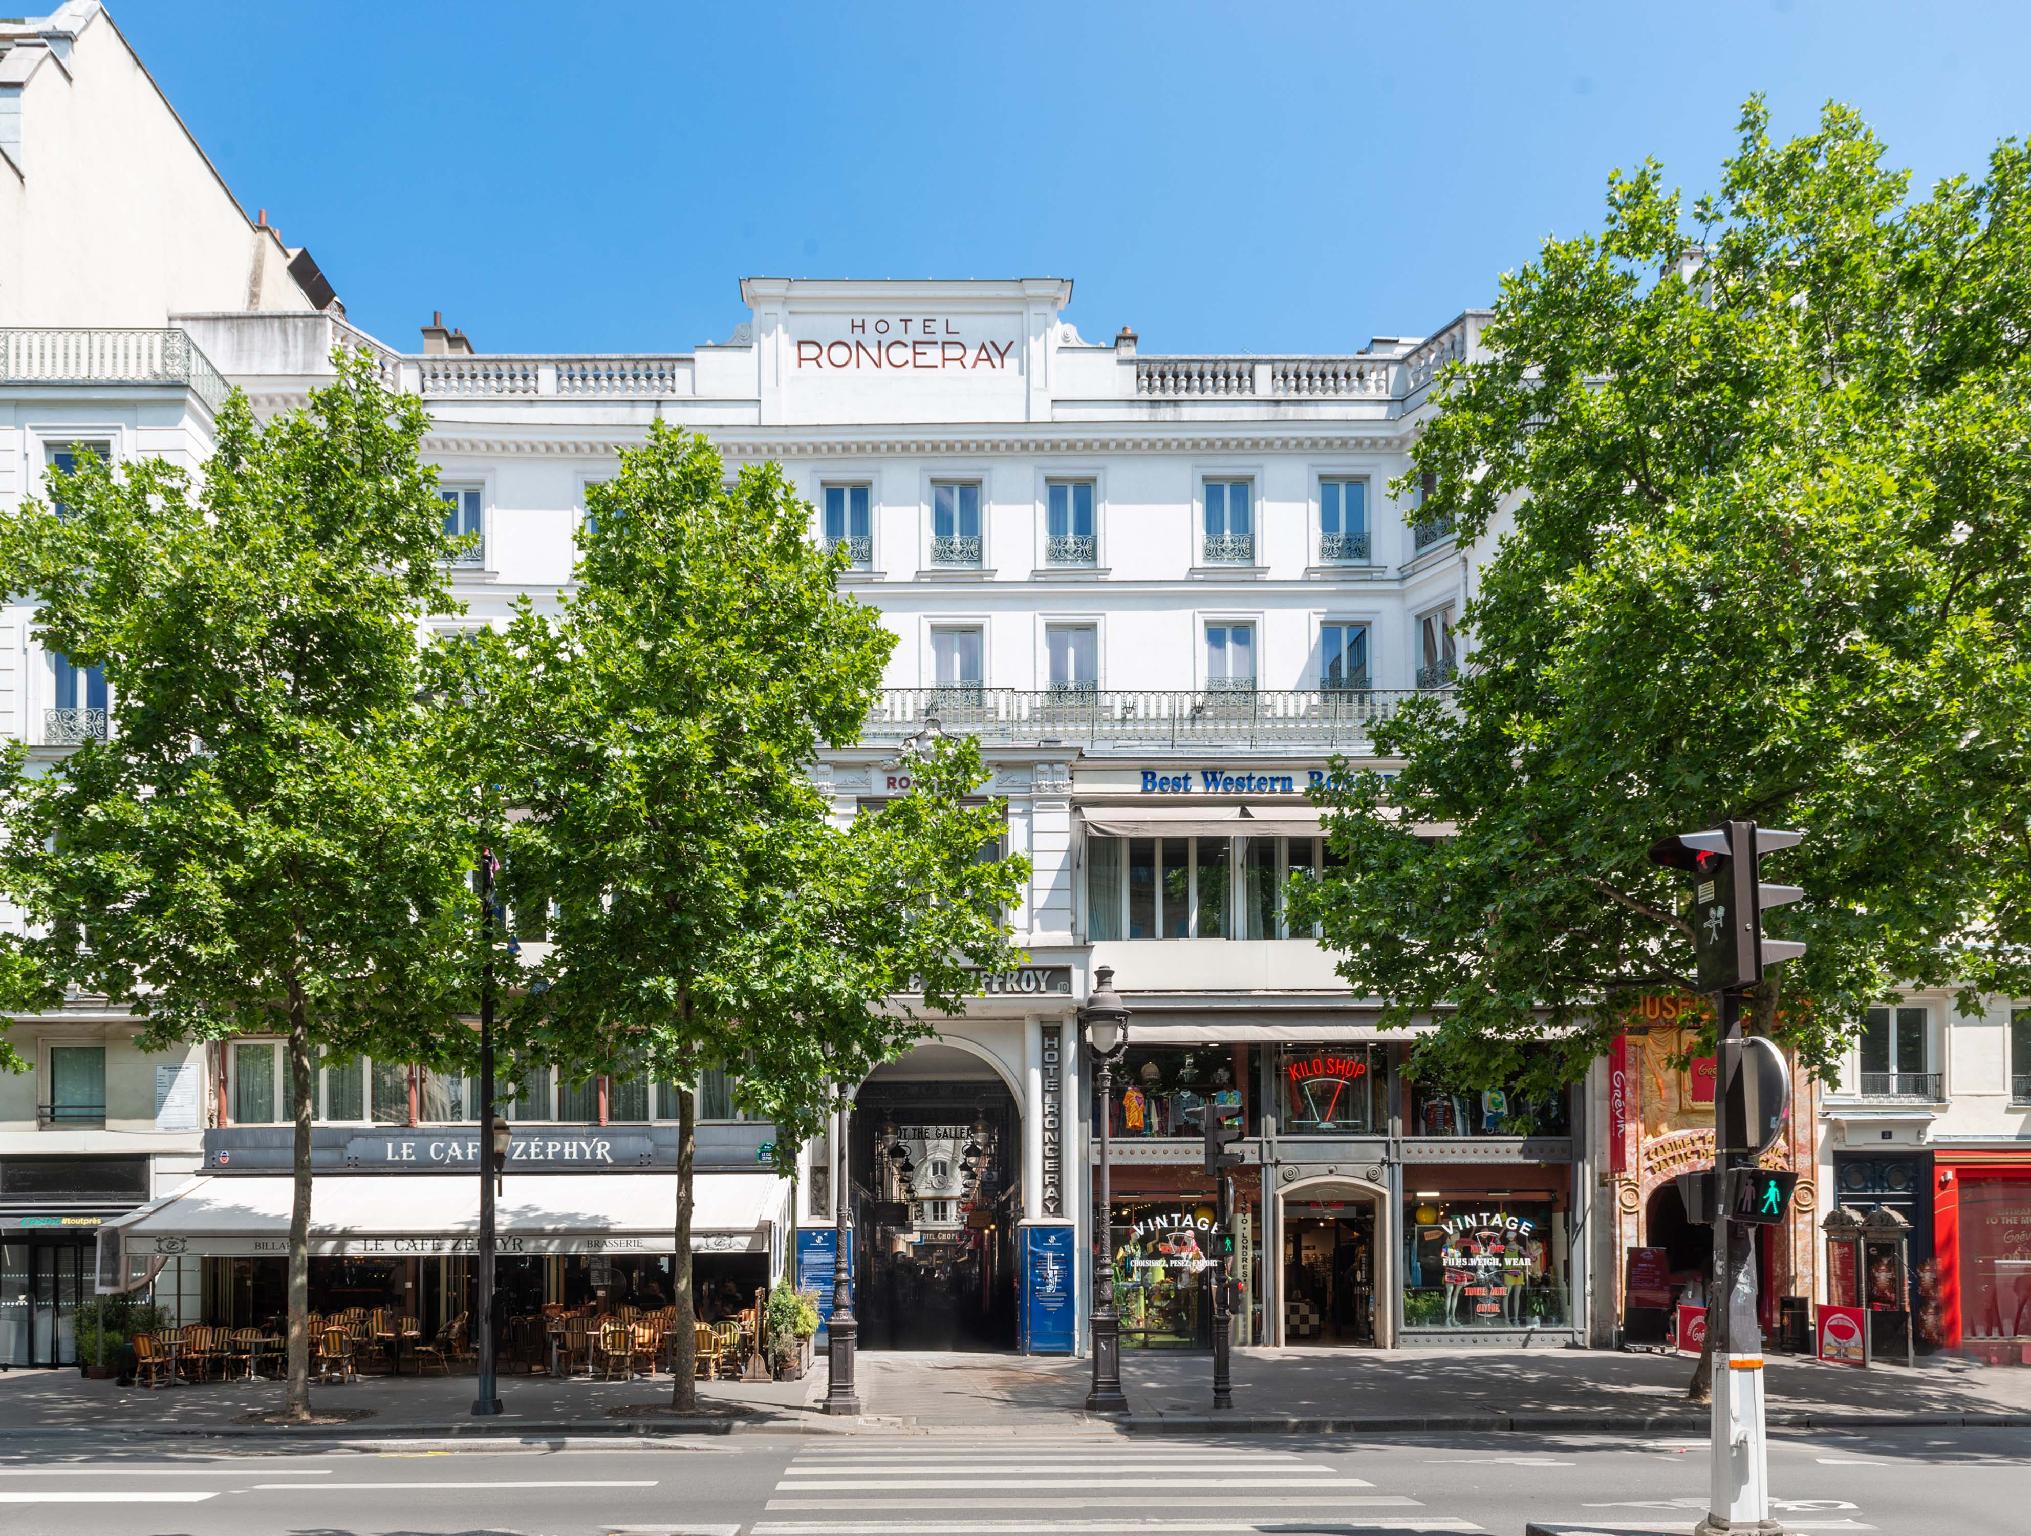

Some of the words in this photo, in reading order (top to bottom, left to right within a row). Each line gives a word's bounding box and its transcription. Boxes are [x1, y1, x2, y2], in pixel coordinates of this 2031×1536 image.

[851, 318, 960, 335] HOTEL
[797, 340, 1014, 369] RONCERAY
[1140, 770, 1192, 793] Best
[1200, 770, 1294, 793] Western
[1044, 1037, 1059, 1103] HOTEL
[1289, 1058, 1323, 1081] KILO
[1326, 1058, 1366, 1078] SHOP
[912, 1128, 930, 1139] THE
[935, 1128, 973, 1140] GALLER
[386, 1142, 416, 1161] LE
[429, 1141, 481, 1164] CAF
[512, 1137, 614, 1163] ZÉPHYR
[1043, 1104, 1060, 1213] RONCERAY
[1441, 1212, 1533, 1237] VINTAGE
[363, 1239, 384, 1251] LE
[394, 1236, 441, 1251] CAFÉ
[451, 1236, 523, 1251] ZÉYR
[587, 1238, 643, 1248] BRASSERIE
[1504, 1257, 1532, 1266] WEAR
